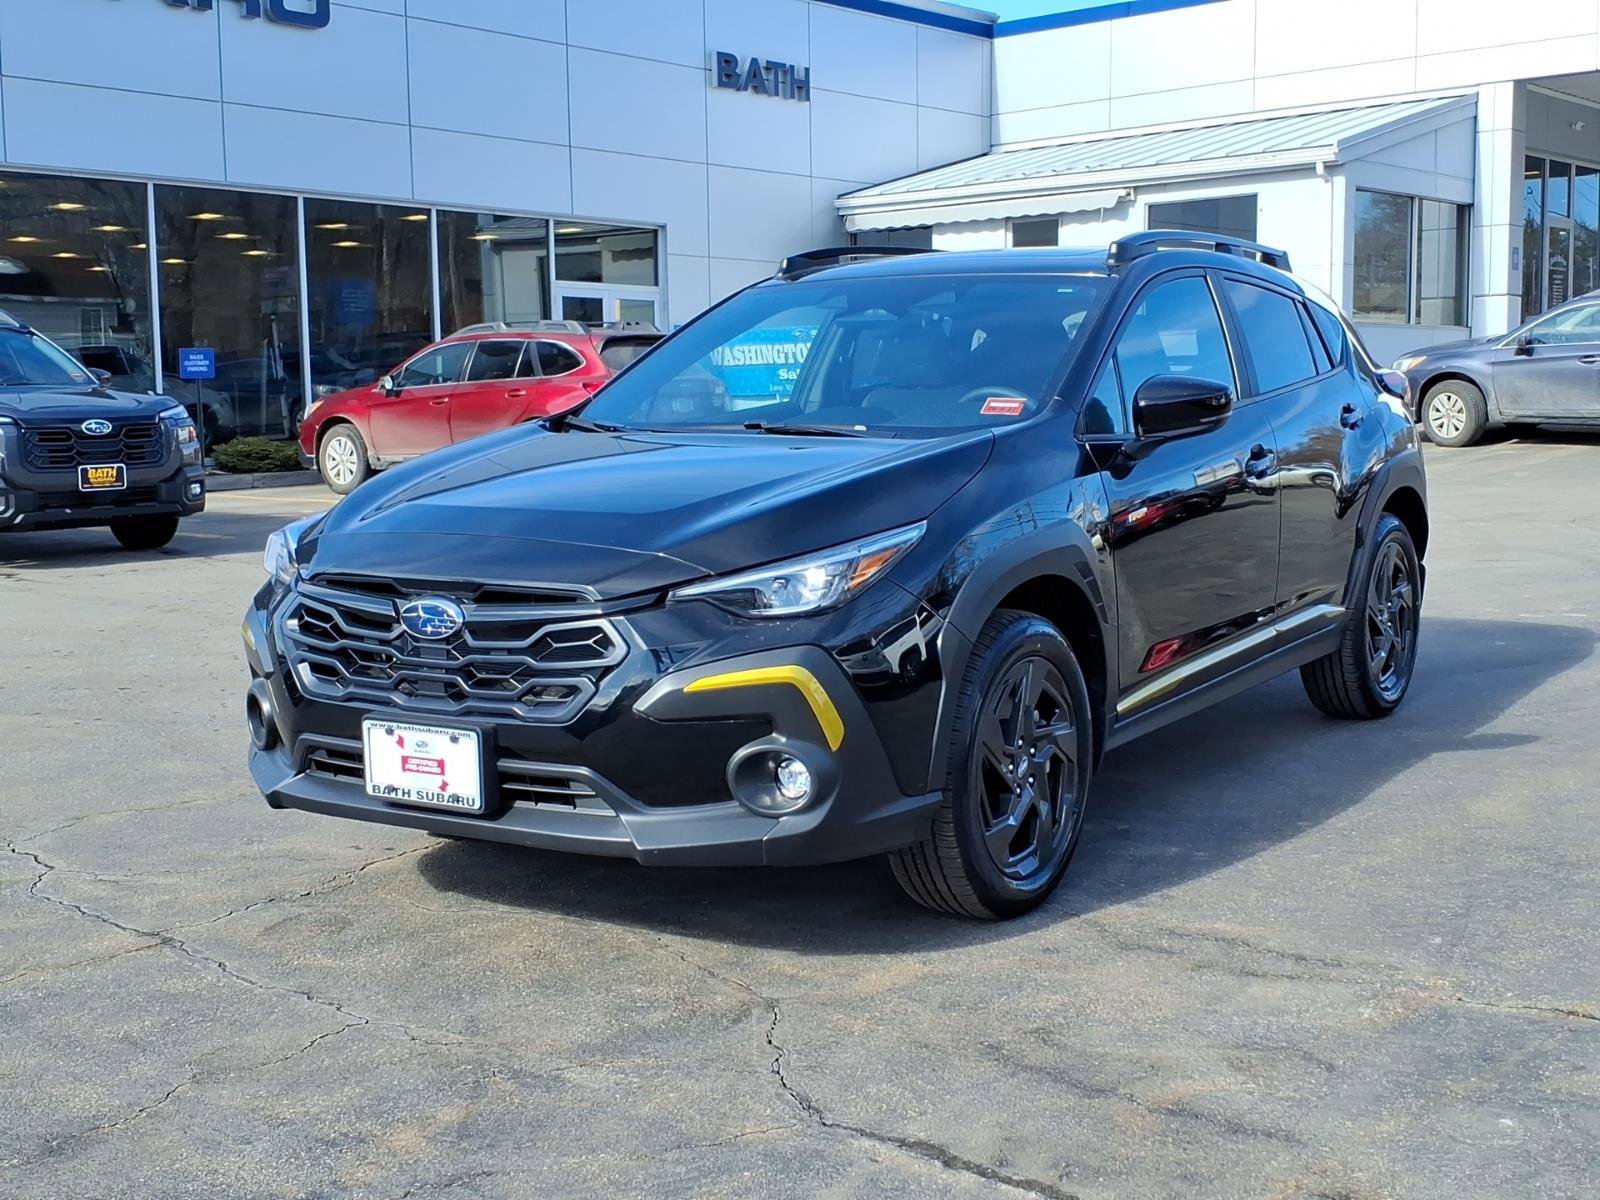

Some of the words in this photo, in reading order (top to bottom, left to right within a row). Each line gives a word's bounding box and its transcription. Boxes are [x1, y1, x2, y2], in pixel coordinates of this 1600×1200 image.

[713, 51, 810, 102] BATH
[88, 468, 117, 478] BATH
[369, 722, 471, 740] www.bathsubaru.com
[372, 784, 411, 798] BATH
[416, 790, 476, 807] SUBARU
